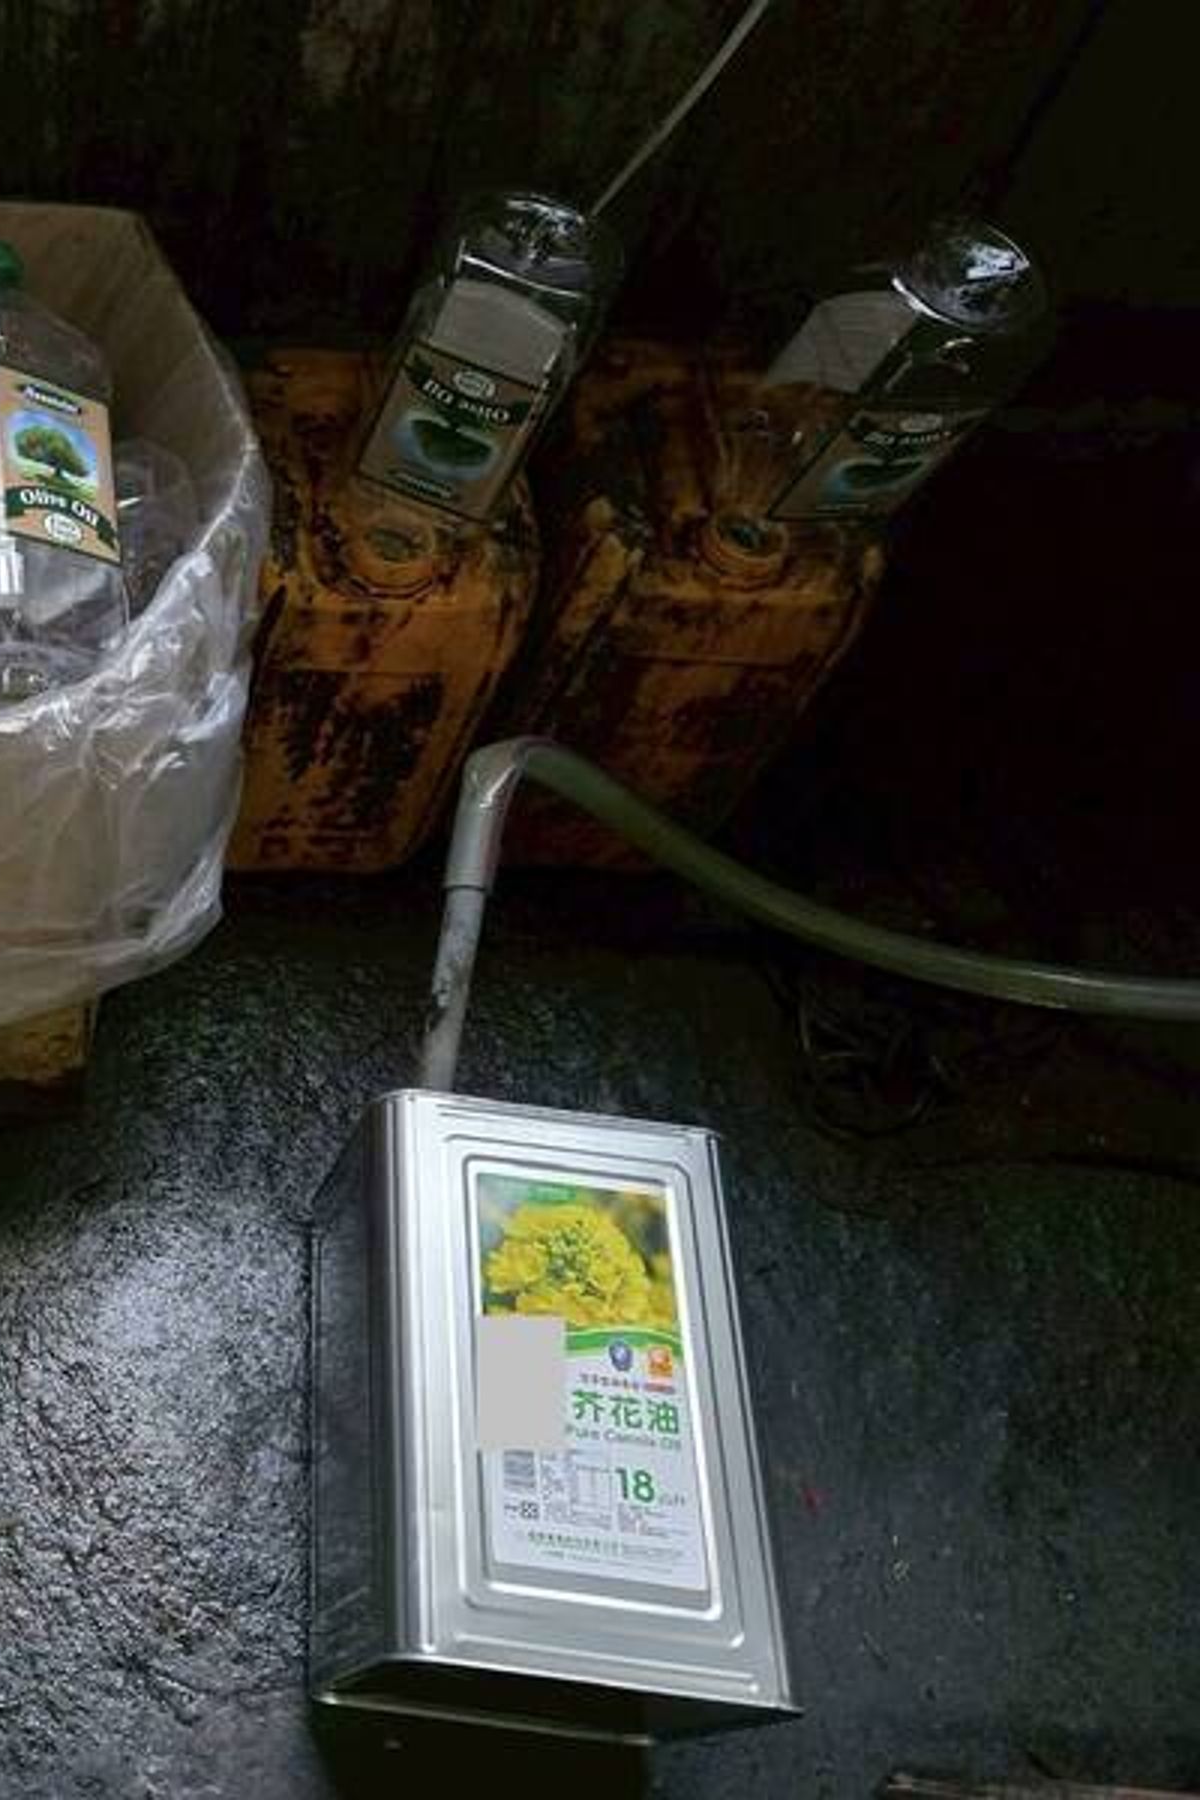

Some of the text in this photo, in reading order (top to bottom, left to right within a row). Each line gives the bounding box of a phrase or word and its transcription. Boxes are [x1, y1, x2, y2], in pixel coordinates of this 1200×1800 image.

[19, 487, 67, 509] Olive
[71, 501, 99, 527] Oil
[572, 1390, 680, 1435] 芥花油
[615, 1465, 656, 1503] 18
